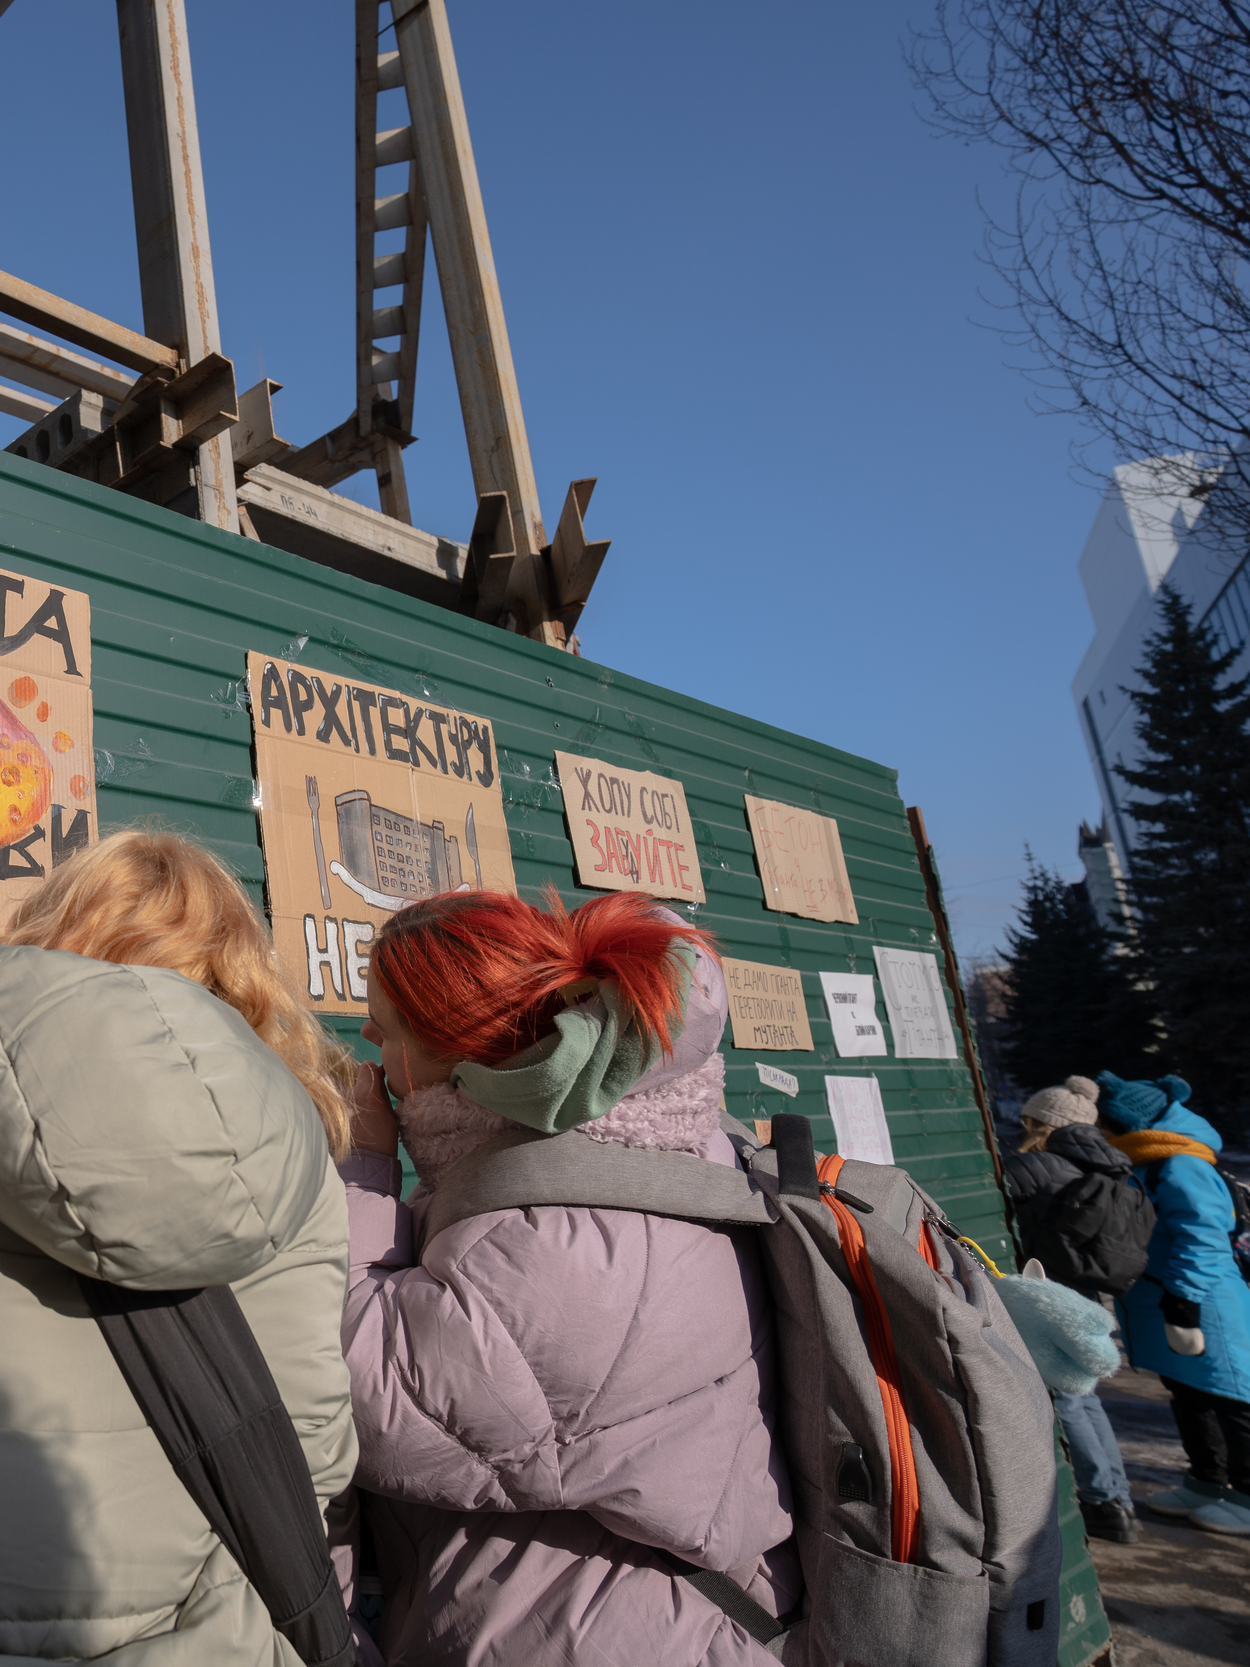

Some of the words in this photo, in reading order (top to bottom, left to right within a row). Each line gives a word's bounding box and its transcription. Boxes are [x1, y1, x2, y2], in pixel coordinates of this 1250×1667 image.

[261, 661, 494, 788] АРХІТЕКТУРУ
[574, 766, 632, 818] ЖОПУ
[639, 786, 680, 833] СОБІ
[754, 806, 825, 859] БЕТОН
[303, 913, 376, 1003] НЕ
[728, 966, 741, 990] НЕ
[743, 968, 769, 993] ДАМО
[770, 973, 802, 998] ГІГАНТА
[733, 994, 785, 1021] ПЕРЕТВОРИТИ
[785, 1000, 799, 1022] НА
[753, 1023, 799, 1047] МУТАНТА
